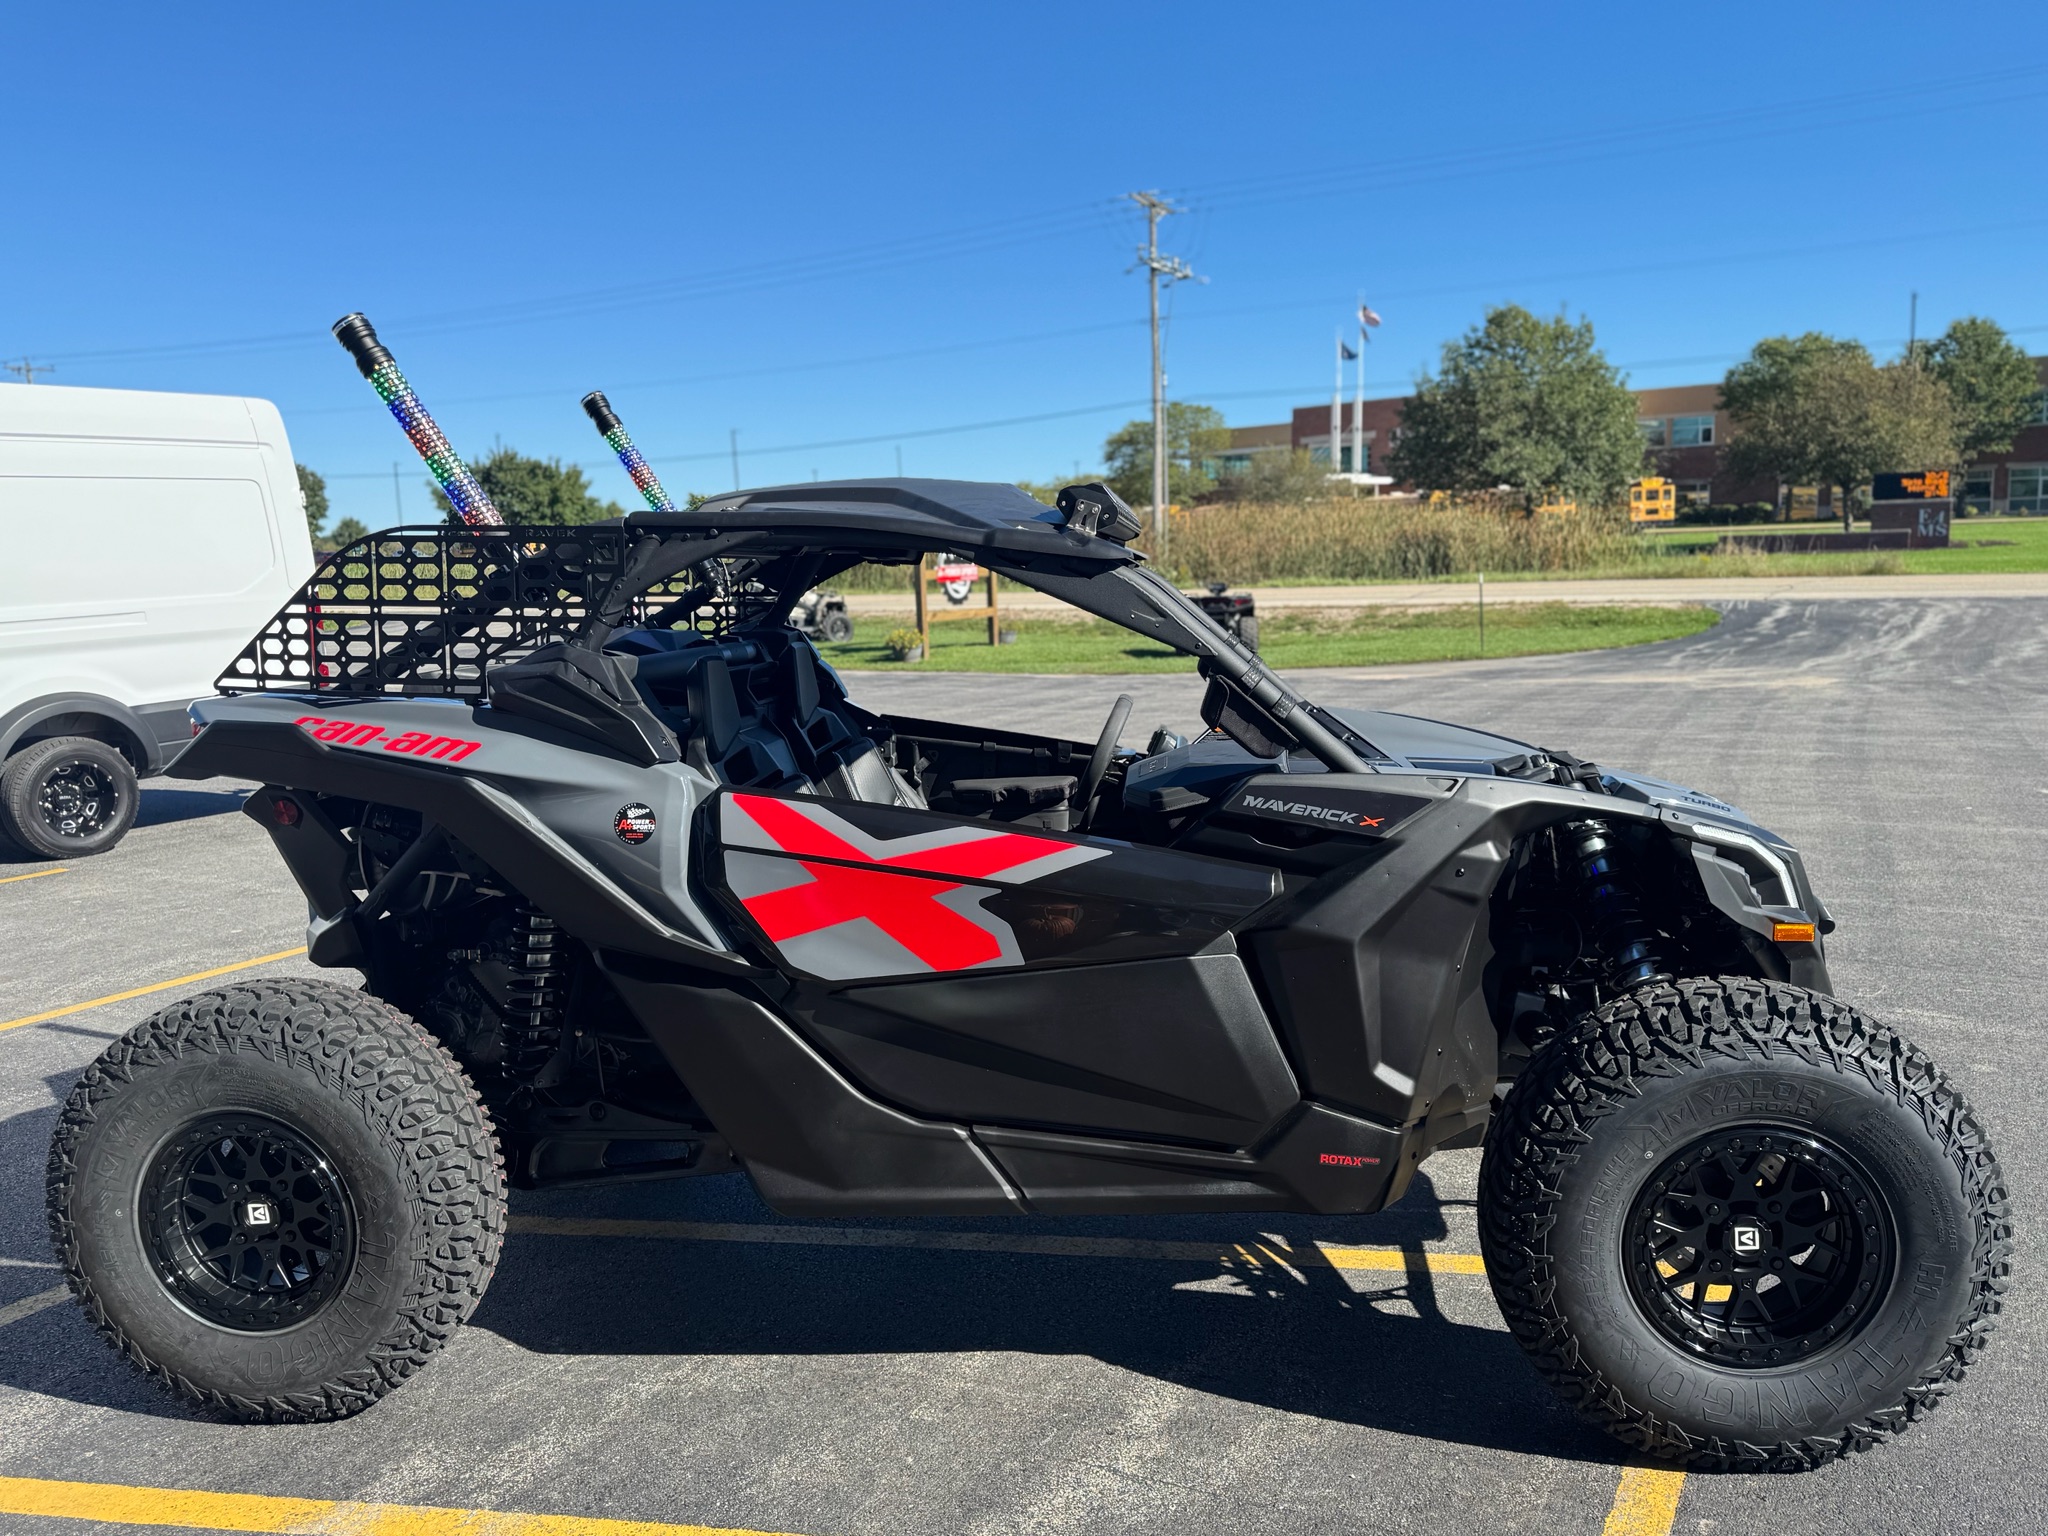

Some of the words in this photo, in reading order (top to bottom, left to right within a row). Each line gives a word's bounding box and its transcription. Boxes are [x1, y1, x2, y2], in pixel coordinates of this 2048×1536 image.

[525, 528, 577, 538] RAVEK
[293, 716, 483, 762] can-am
[1242, 794, 1360, 825] MAVERICK
[1359, 815, 1386, 828] X
[1680, 795, 1731, 812] TURBO
[1695, 1078, 1821, 1109] VALOR
[1711, 1100, 1813, 1117] OFFROAD
[1320, 1153, 1362, 1167] ROTAX
[1361, 1157, 1380, 1165] POWER
[1913, 1262, 1946, 1300] H1
[246, 1231, 397, 1386] TANGO
[1647, 1339, 1912, 1431] TANGO
